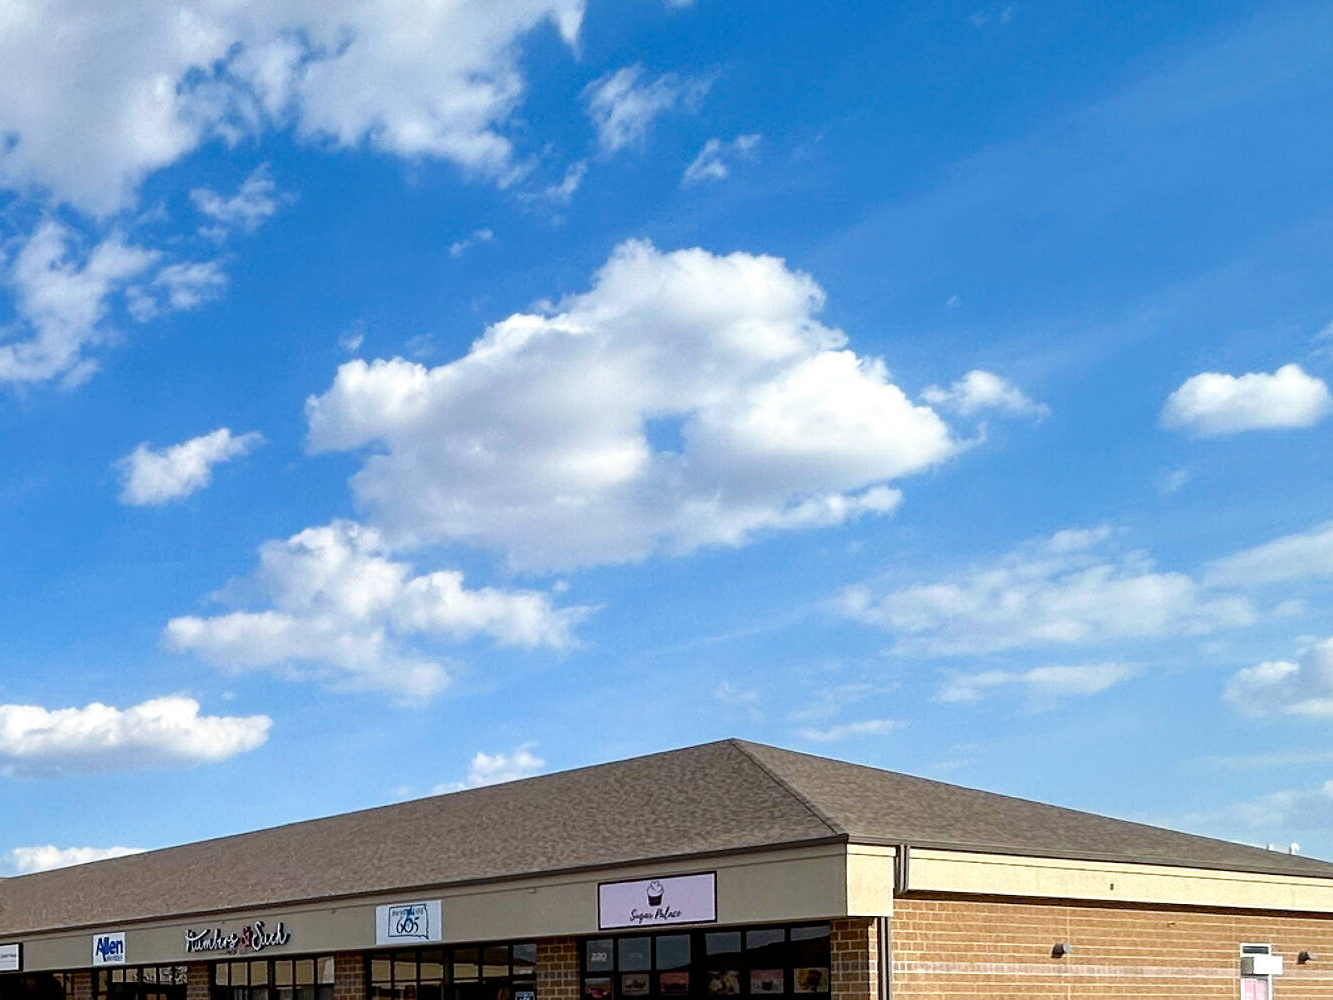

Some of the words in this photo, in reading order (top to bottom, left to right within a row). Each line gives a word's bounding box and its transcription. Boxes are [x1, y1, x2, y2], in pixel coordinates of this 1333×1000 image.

[629, 908, 653, 924] Sugar
[654, 905, 682, 920] Palace
[396, 916, 420, 934] 605
[96, 936, 123, 957] Allen
